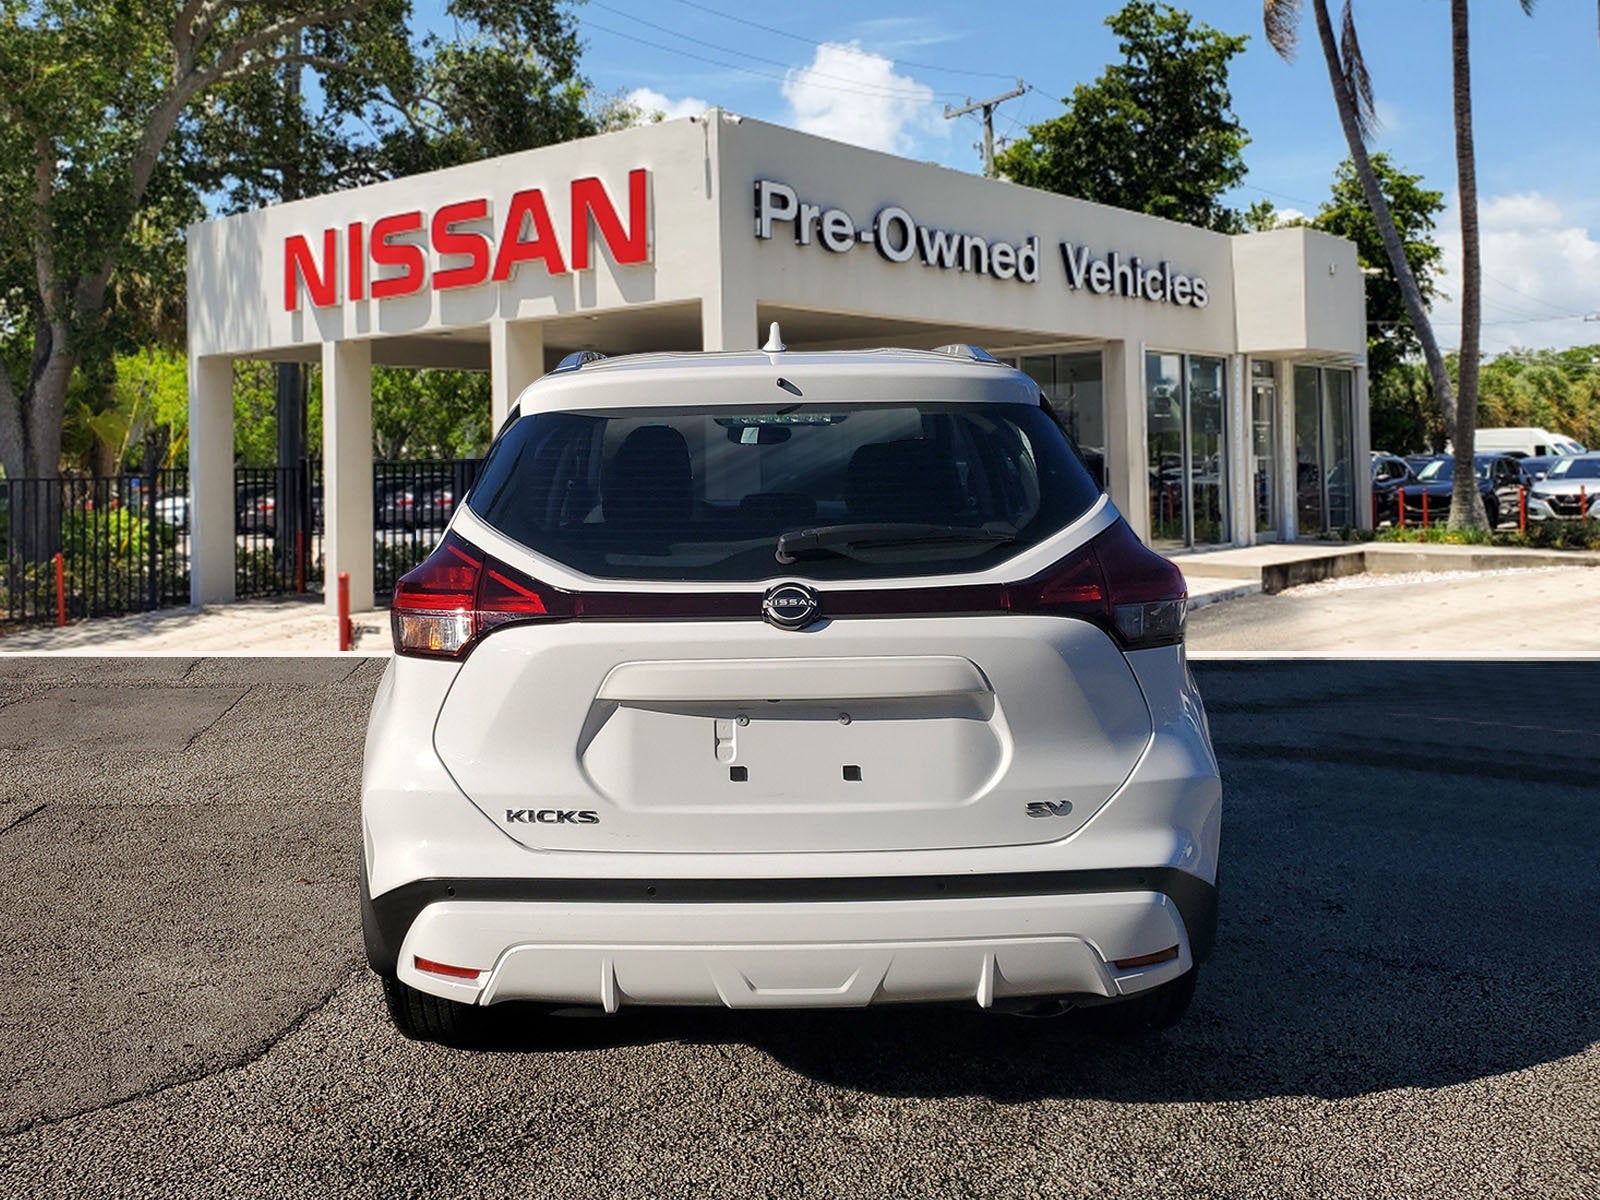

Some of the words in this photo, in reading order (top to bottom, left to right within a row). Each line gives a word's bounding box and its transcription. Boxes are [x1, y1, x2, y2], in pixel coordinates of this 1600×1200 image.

[284, 168, 649, 312] NISSAN
[754, 180, 1040, 283] Pre-Owned
[1061, 242, 1209, 308] Vehicles
[763, 598, 817, 608] NISSAN
[505, 809, 600, 824] KICKS
[1026, 800, 1073, 818] SV
